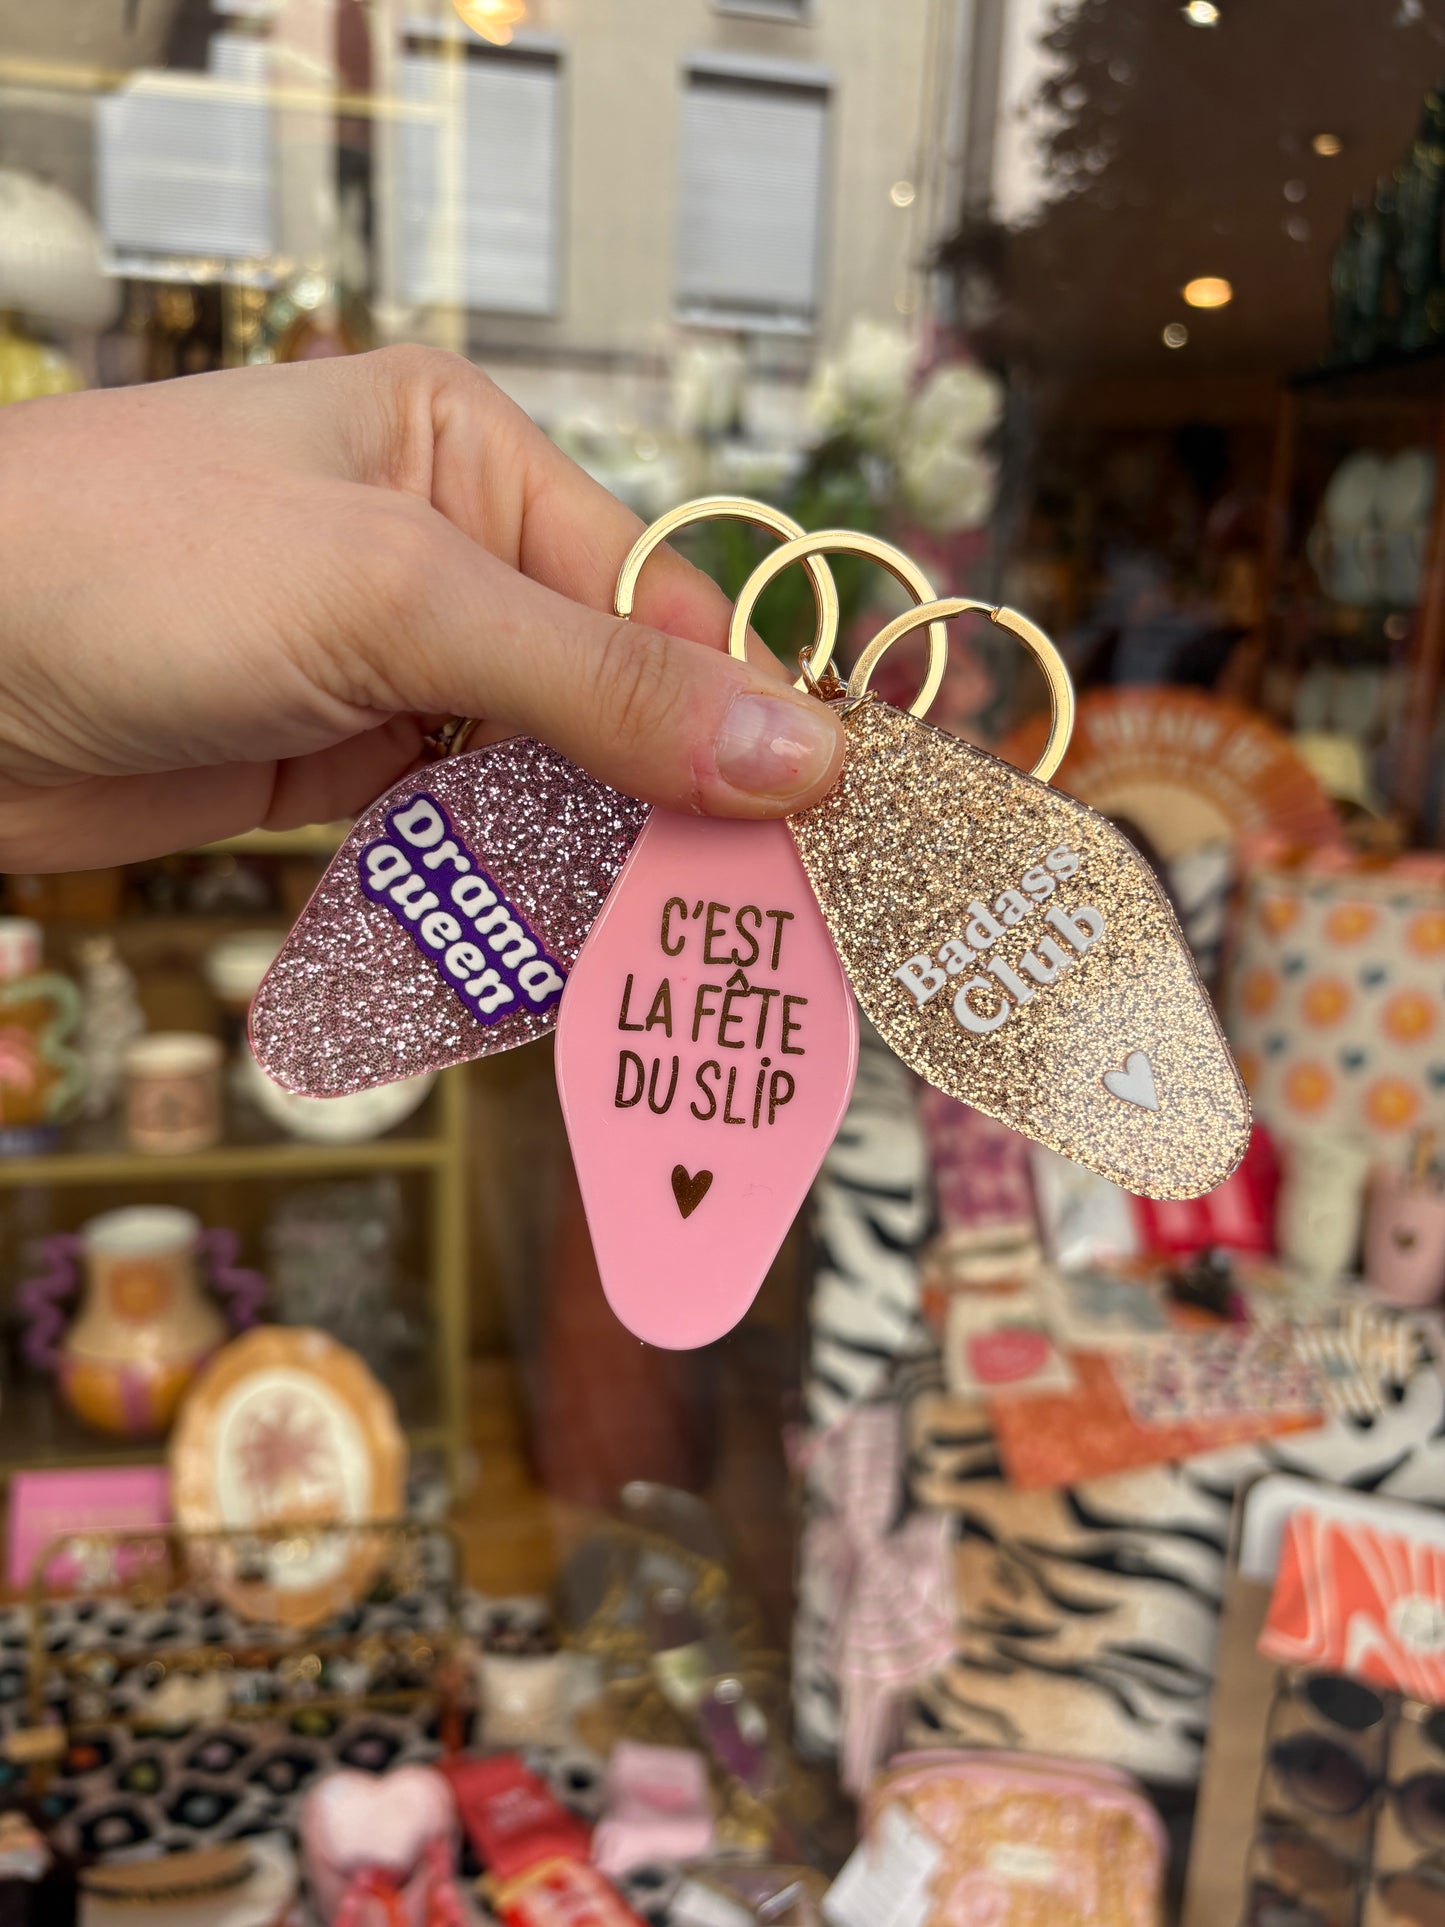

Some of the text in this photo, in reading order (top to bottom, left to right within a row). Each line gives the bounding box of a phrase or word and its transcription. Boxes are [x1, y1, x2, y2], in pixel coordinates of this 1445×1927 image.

[366, 844, 514, 1014] queen
[392, 798, 564, 1003] Drama
[660, 896, 795, 971] C'EST
[892, 845, 1079, 1006] Badass
[618, 968, 808, 1055] LA FÊTE
[953, 905, 1105, 1034] Club
[615, 1049, 679, 1114] DU
